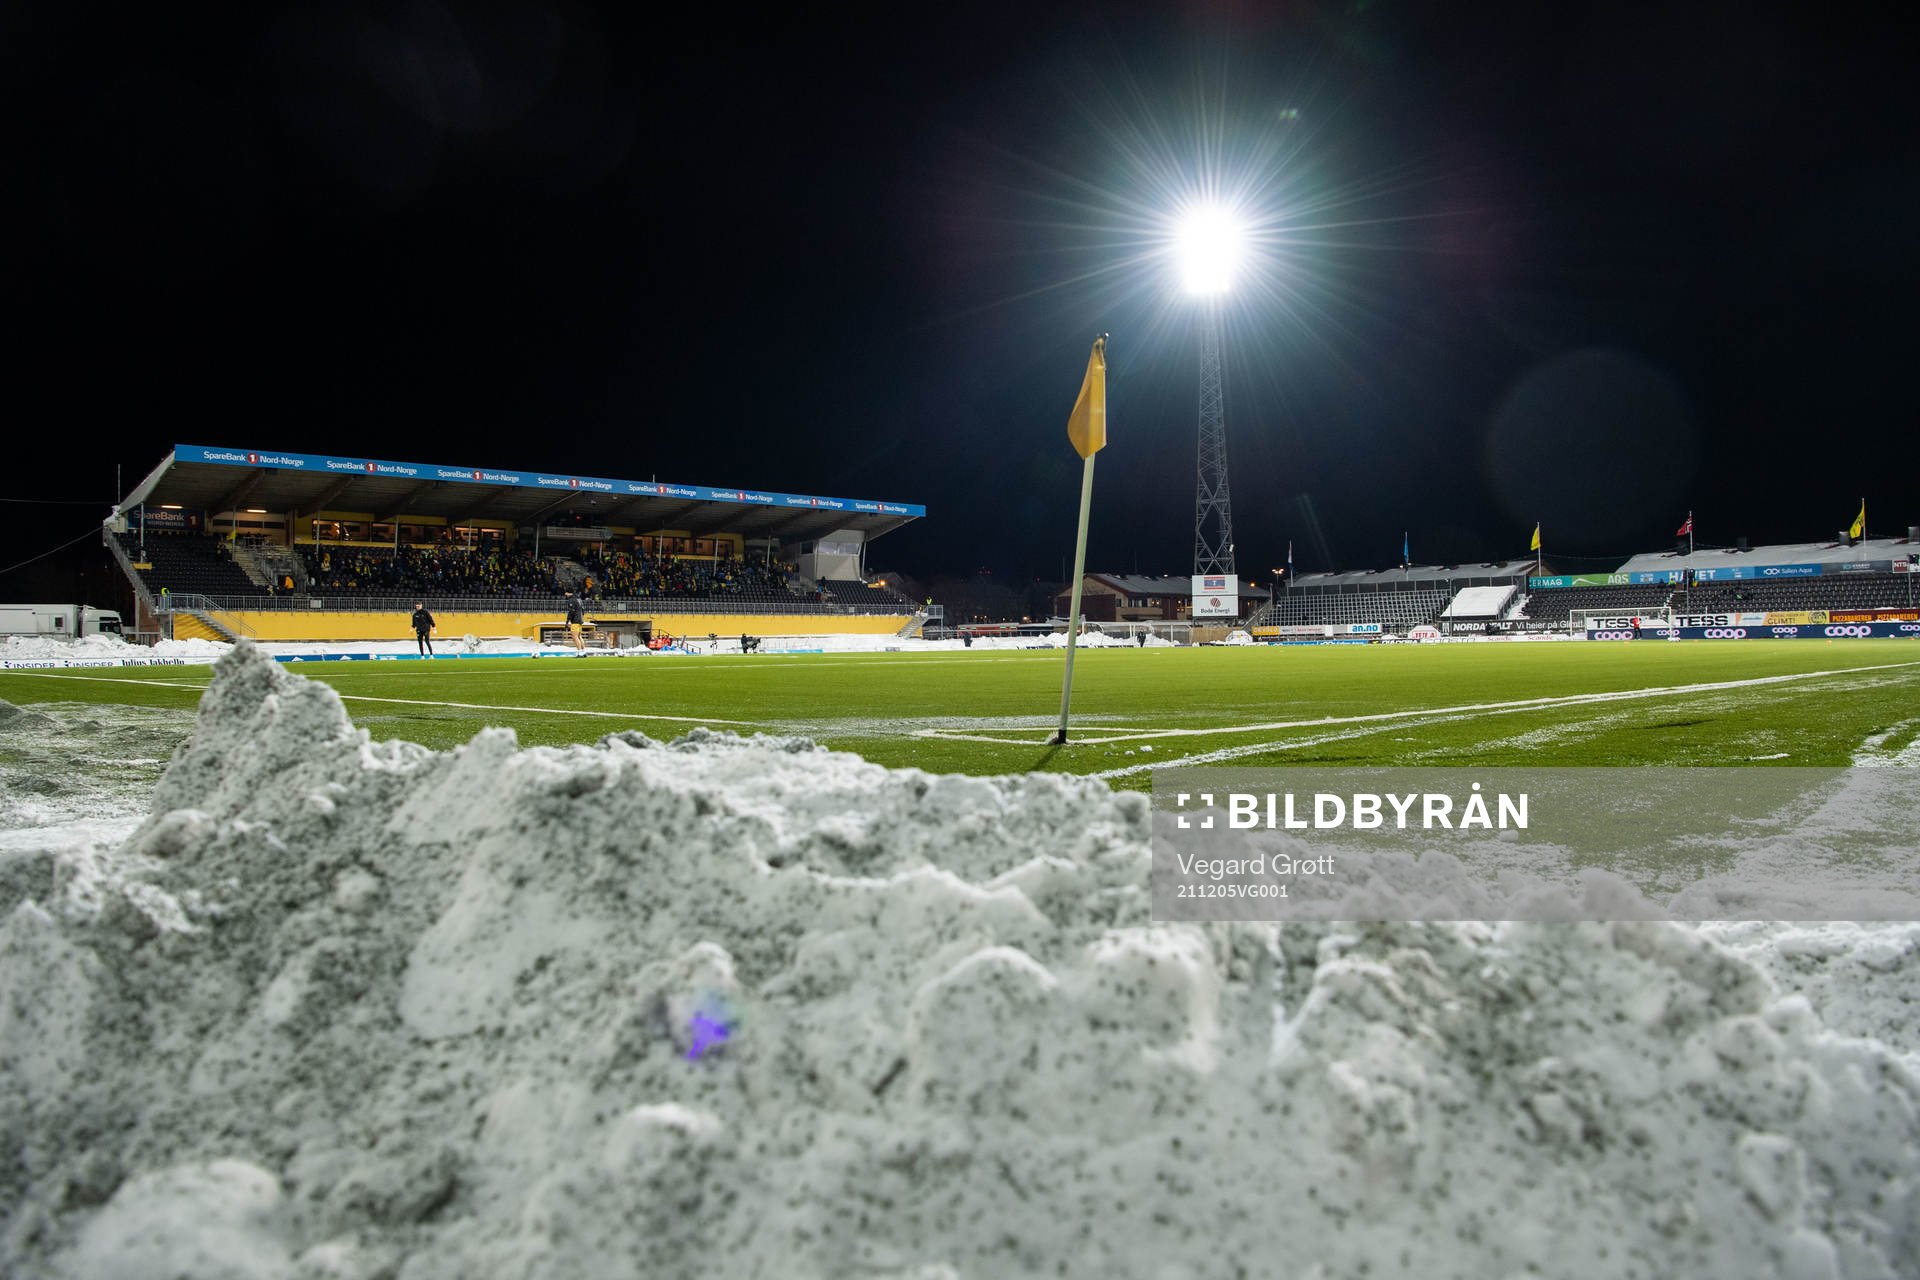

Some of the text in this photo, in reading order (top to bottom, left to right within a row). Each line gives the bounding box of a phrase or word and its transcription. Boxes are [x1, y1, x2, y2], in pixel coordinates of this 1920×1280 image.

[204, 451, 246, 461] SpareBank
[260, 456, 304, 467] Nord-Norge
[326, 460, 365, 470] SpareBank
[377, 465, 417, 475] Nord-Norge
[437, 469, 472, 479] SpareBank
[483, 473, 519, 483] Nord-Norge
[537, 477, 569, 486] SpareBank
[579, 480, 612, 490] Nord-Norge
[628, 484, 658, 493] SpareBank
[666, 488, 696, 497] Nord-Norge
[711, 491, 738, 499] SpareBank
[1668, 569, 1717, 581] HET
[1453, 621, 1513, 632] NORDAALT
[1676, 615, 1729, 627] TESS
[1352, 623, 1379, 633] an.no
[1656, 629, 1680, 638] coop
[1704, 628, 1747, 639] coop
[1772, 626, 1798, 635] coop
[1824, 625, 1872, 638] coop
[1594, 631, 1633, 640] coop
